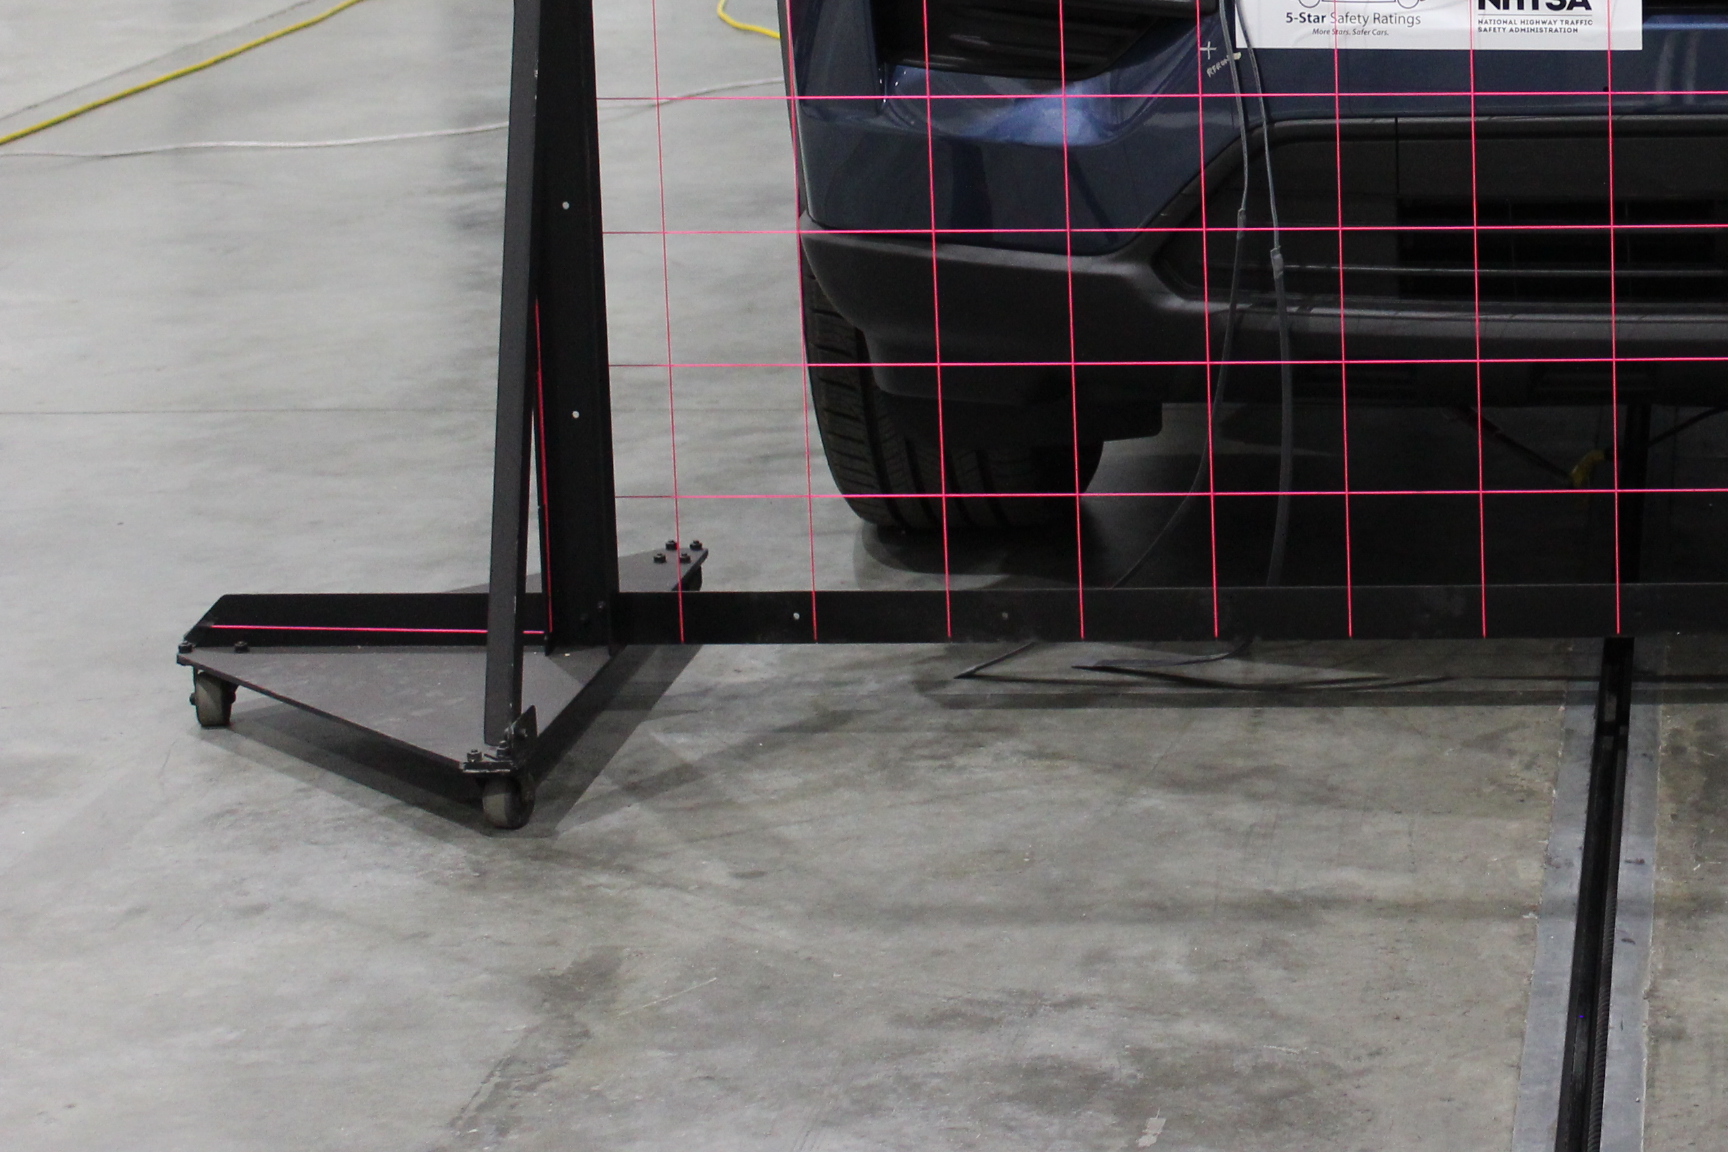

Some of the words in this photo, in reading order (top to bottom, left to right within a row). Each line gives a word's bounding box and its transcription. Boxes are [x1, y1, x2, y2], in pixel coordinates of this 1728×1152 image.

[1285, 12, 1326, 24] 5-Star
[1330, 11, 1369, 27] Safety
[1373, 12, 1421, 28] Ratings
[1312, 28, 1330, 36] More
[1352, 28, 1371, 36] Safer
[1371, 28, 1389, 36] Cars.
